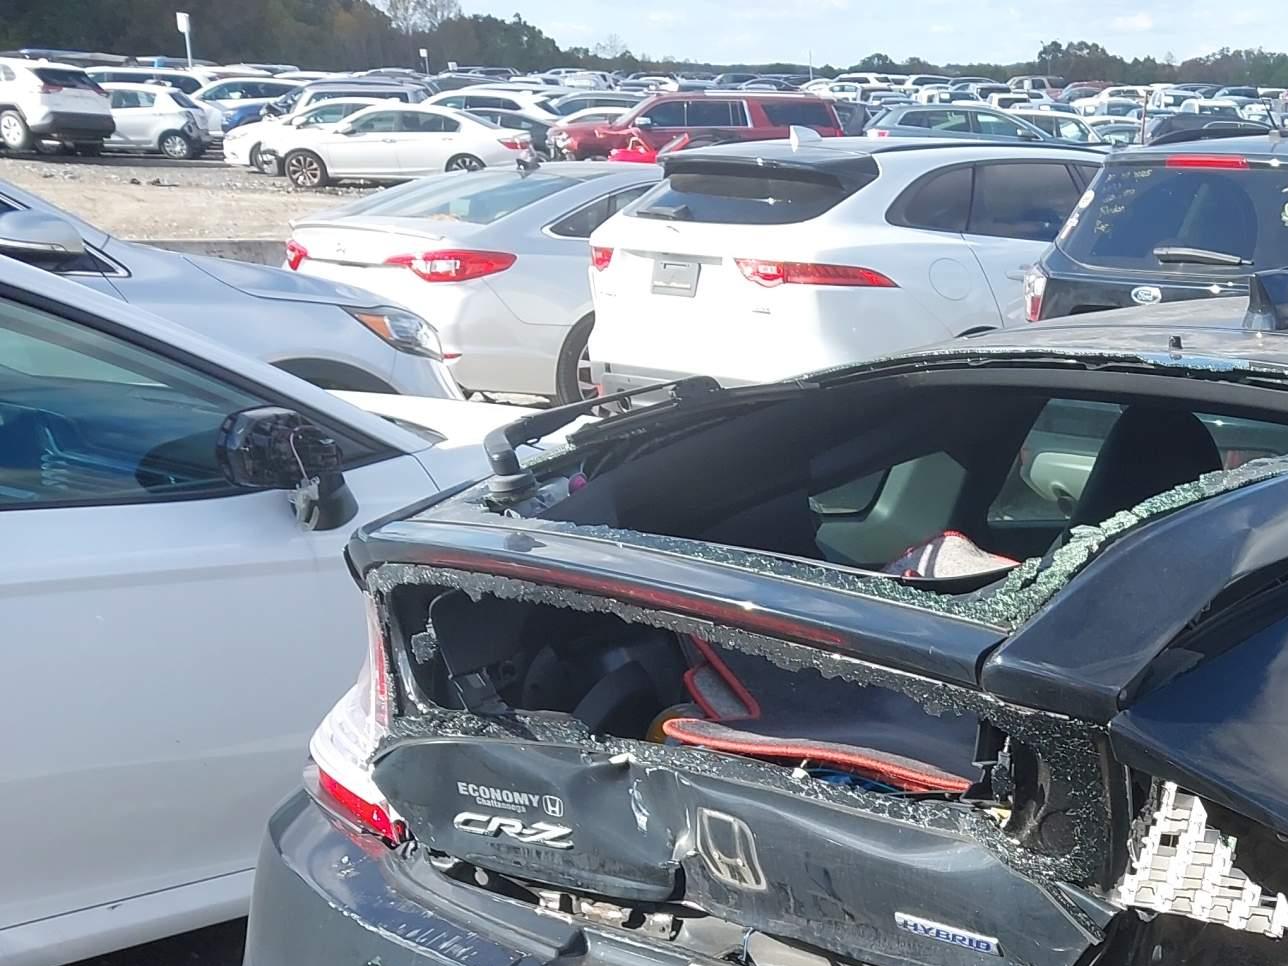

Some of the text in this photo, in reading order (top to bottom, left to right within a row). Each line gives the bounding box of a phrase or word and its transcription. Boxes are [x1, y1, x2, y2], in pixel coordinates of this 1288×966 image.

[457, 782, 540, 808] ECONOMY
[453, 811, 575, 850] CR-Z
[900, 918, 993, 952] HYBRID
